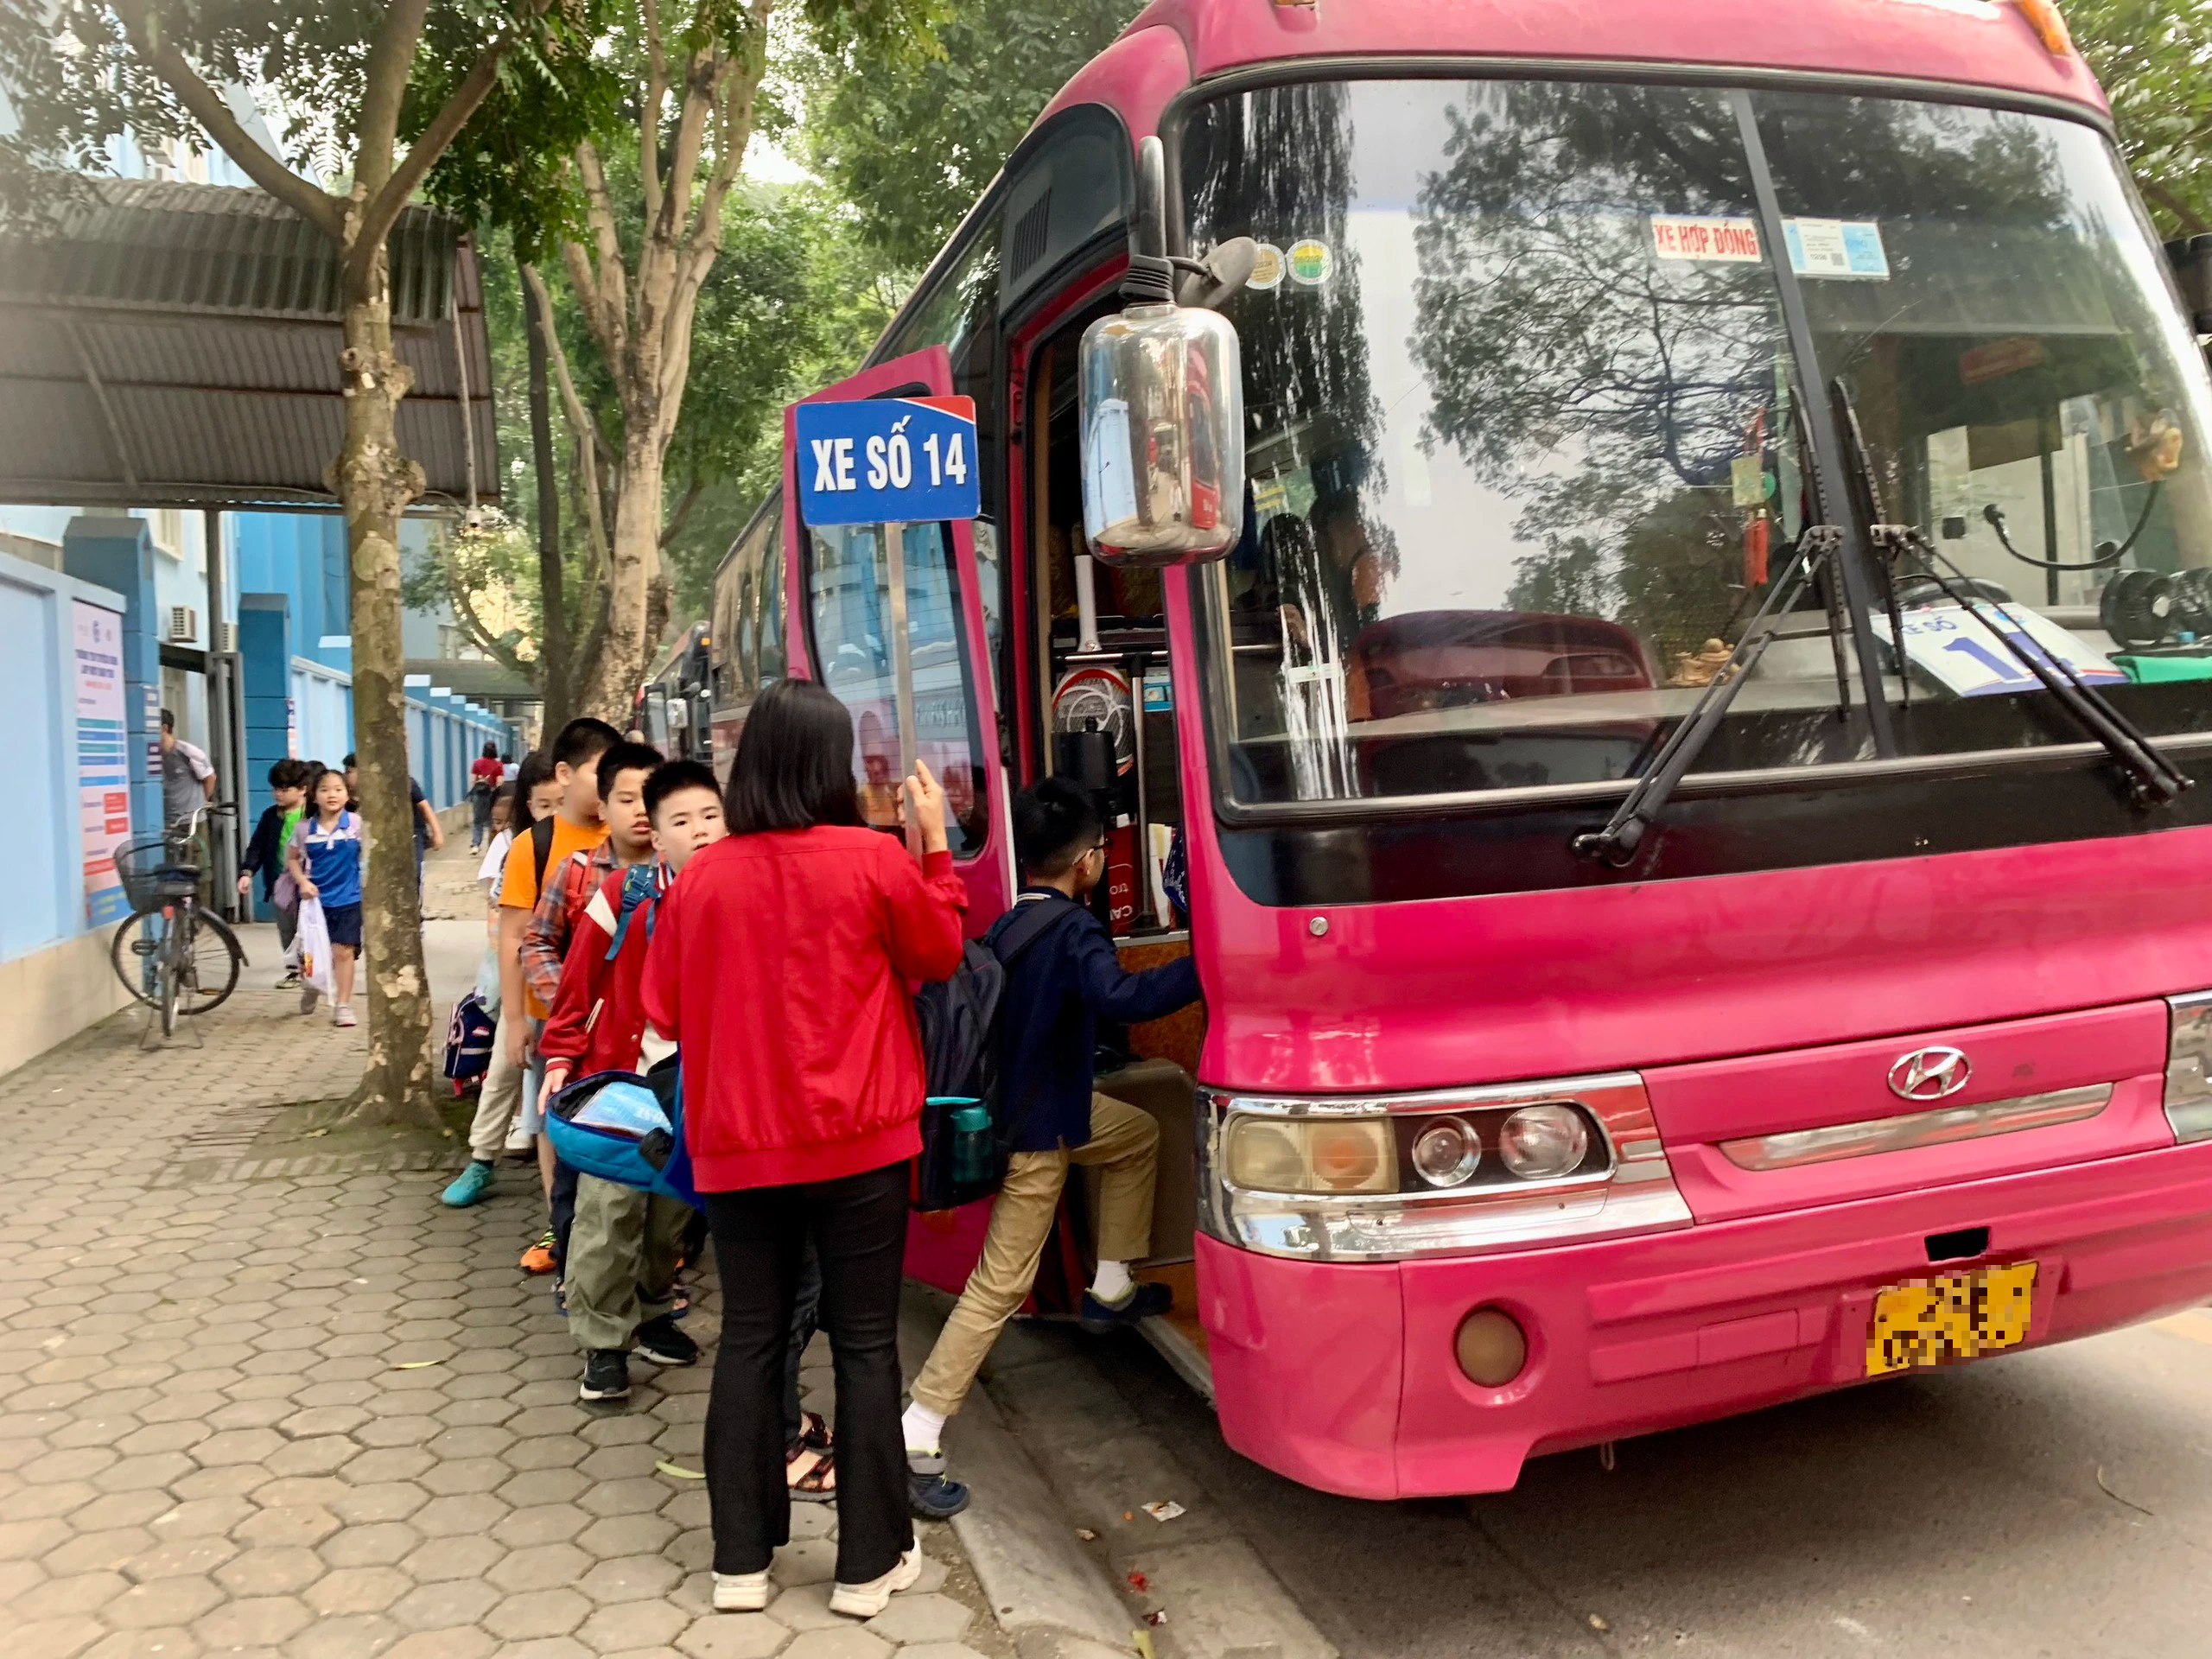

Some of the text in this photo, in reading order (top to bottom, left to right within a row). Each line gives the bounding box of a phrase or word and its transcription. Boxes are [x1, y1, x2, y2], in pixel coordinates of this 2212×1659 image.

[1654, 225, 1676, 251] XE
[810, 415, 967, 492] XE SỐ 14
